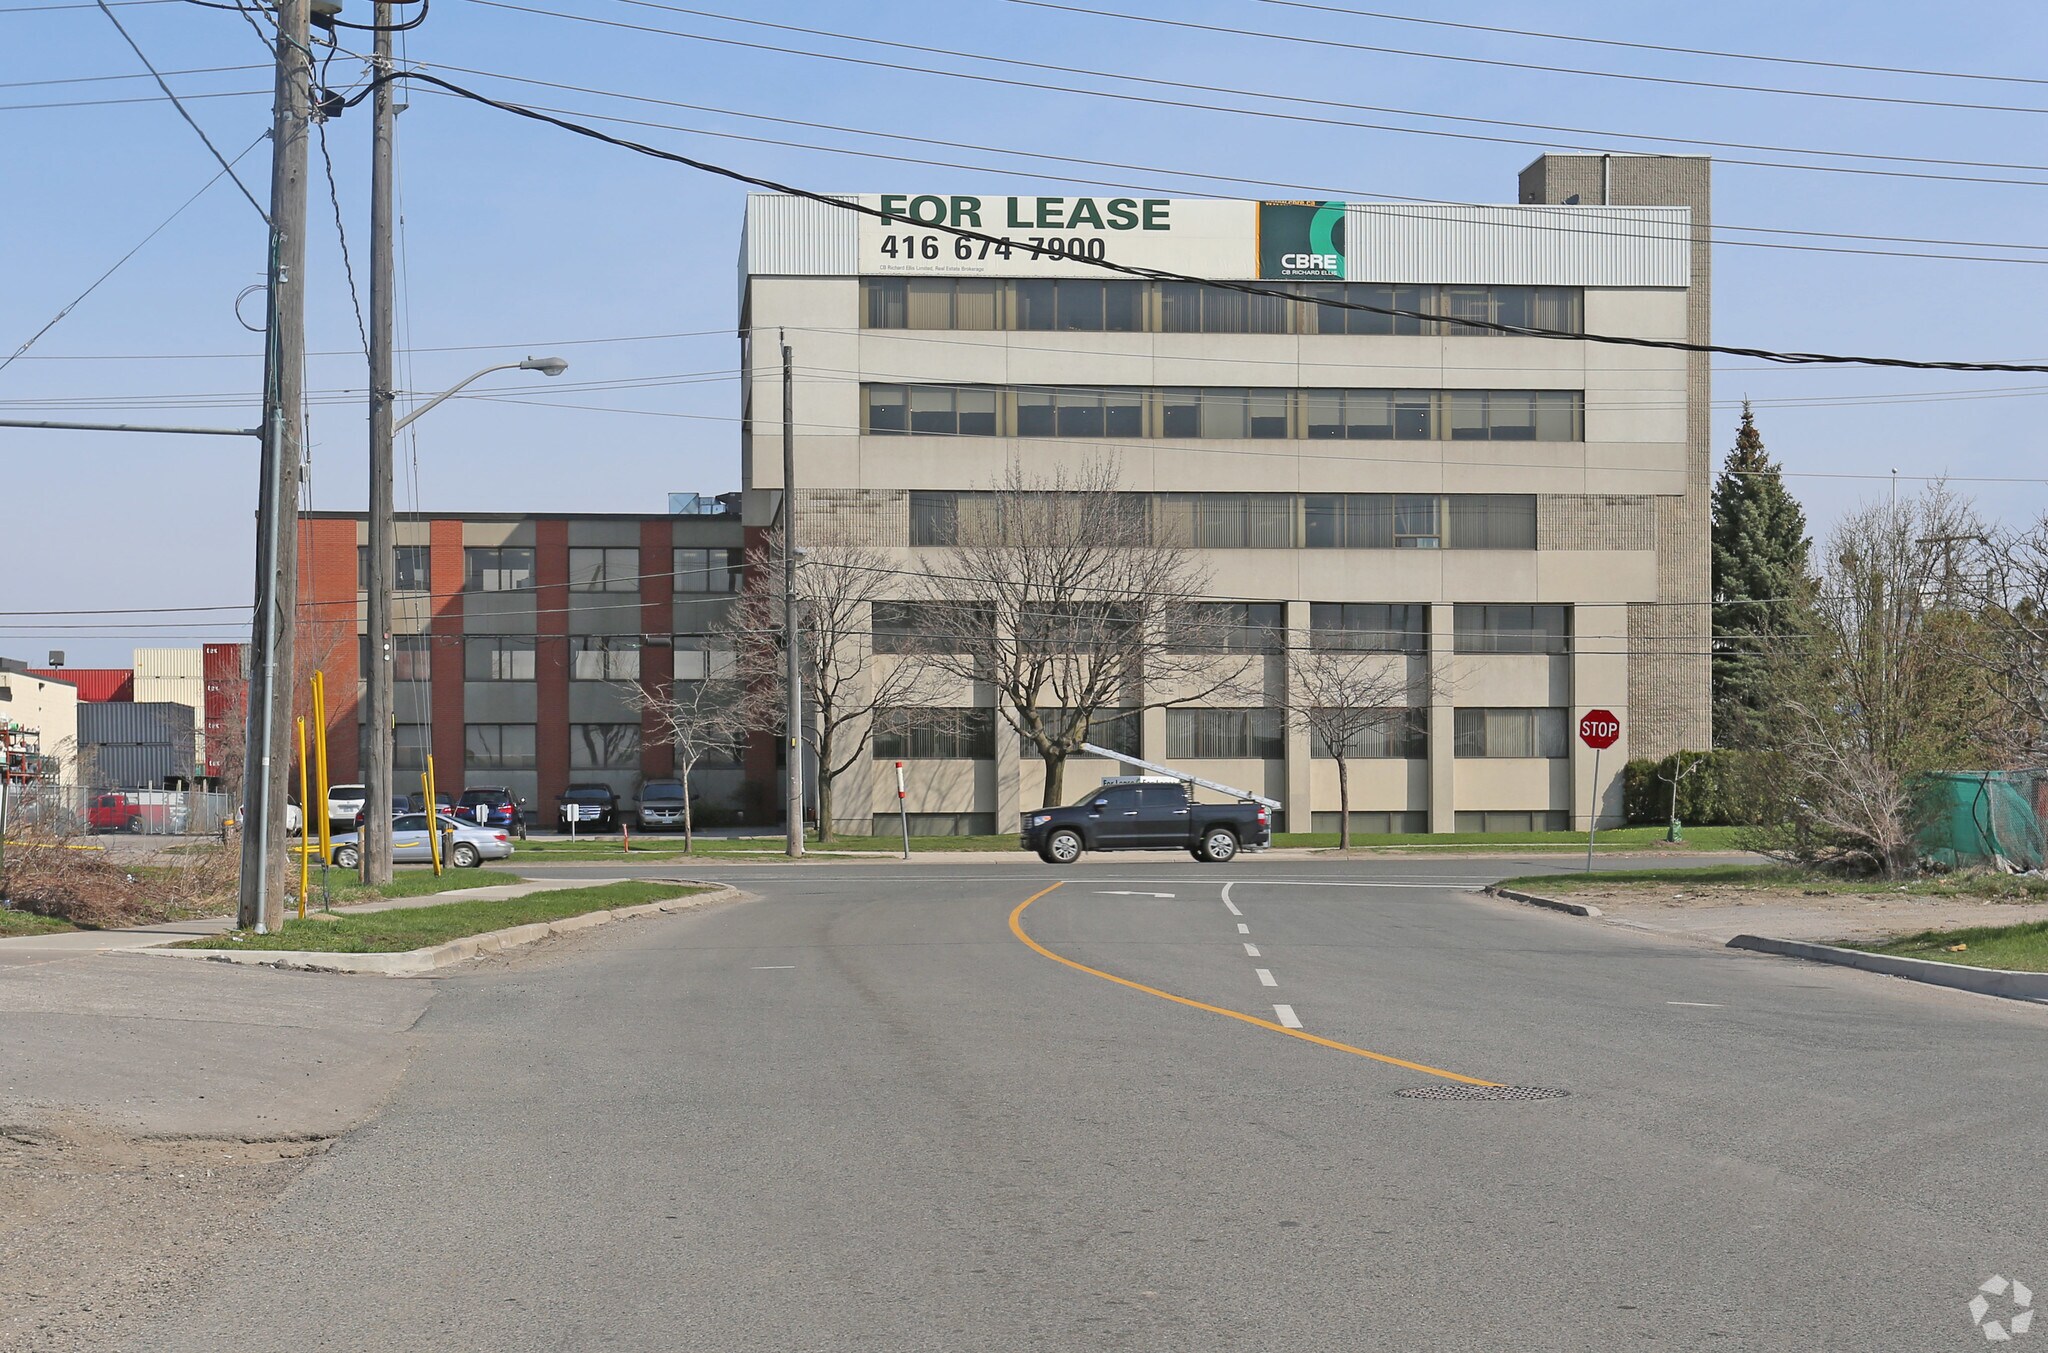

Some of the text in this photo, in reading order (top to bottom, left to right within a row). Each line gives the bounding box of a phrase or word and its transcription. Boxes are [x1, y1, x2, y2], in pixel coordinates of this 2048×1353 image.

[880, 194, 1171, 231] FOR LEASE
[881, 235, 1105, 262] 416 674 7900
[1281, 253, 1338, 269] CBRE
[1581, 720, 1618, 738] STOP
